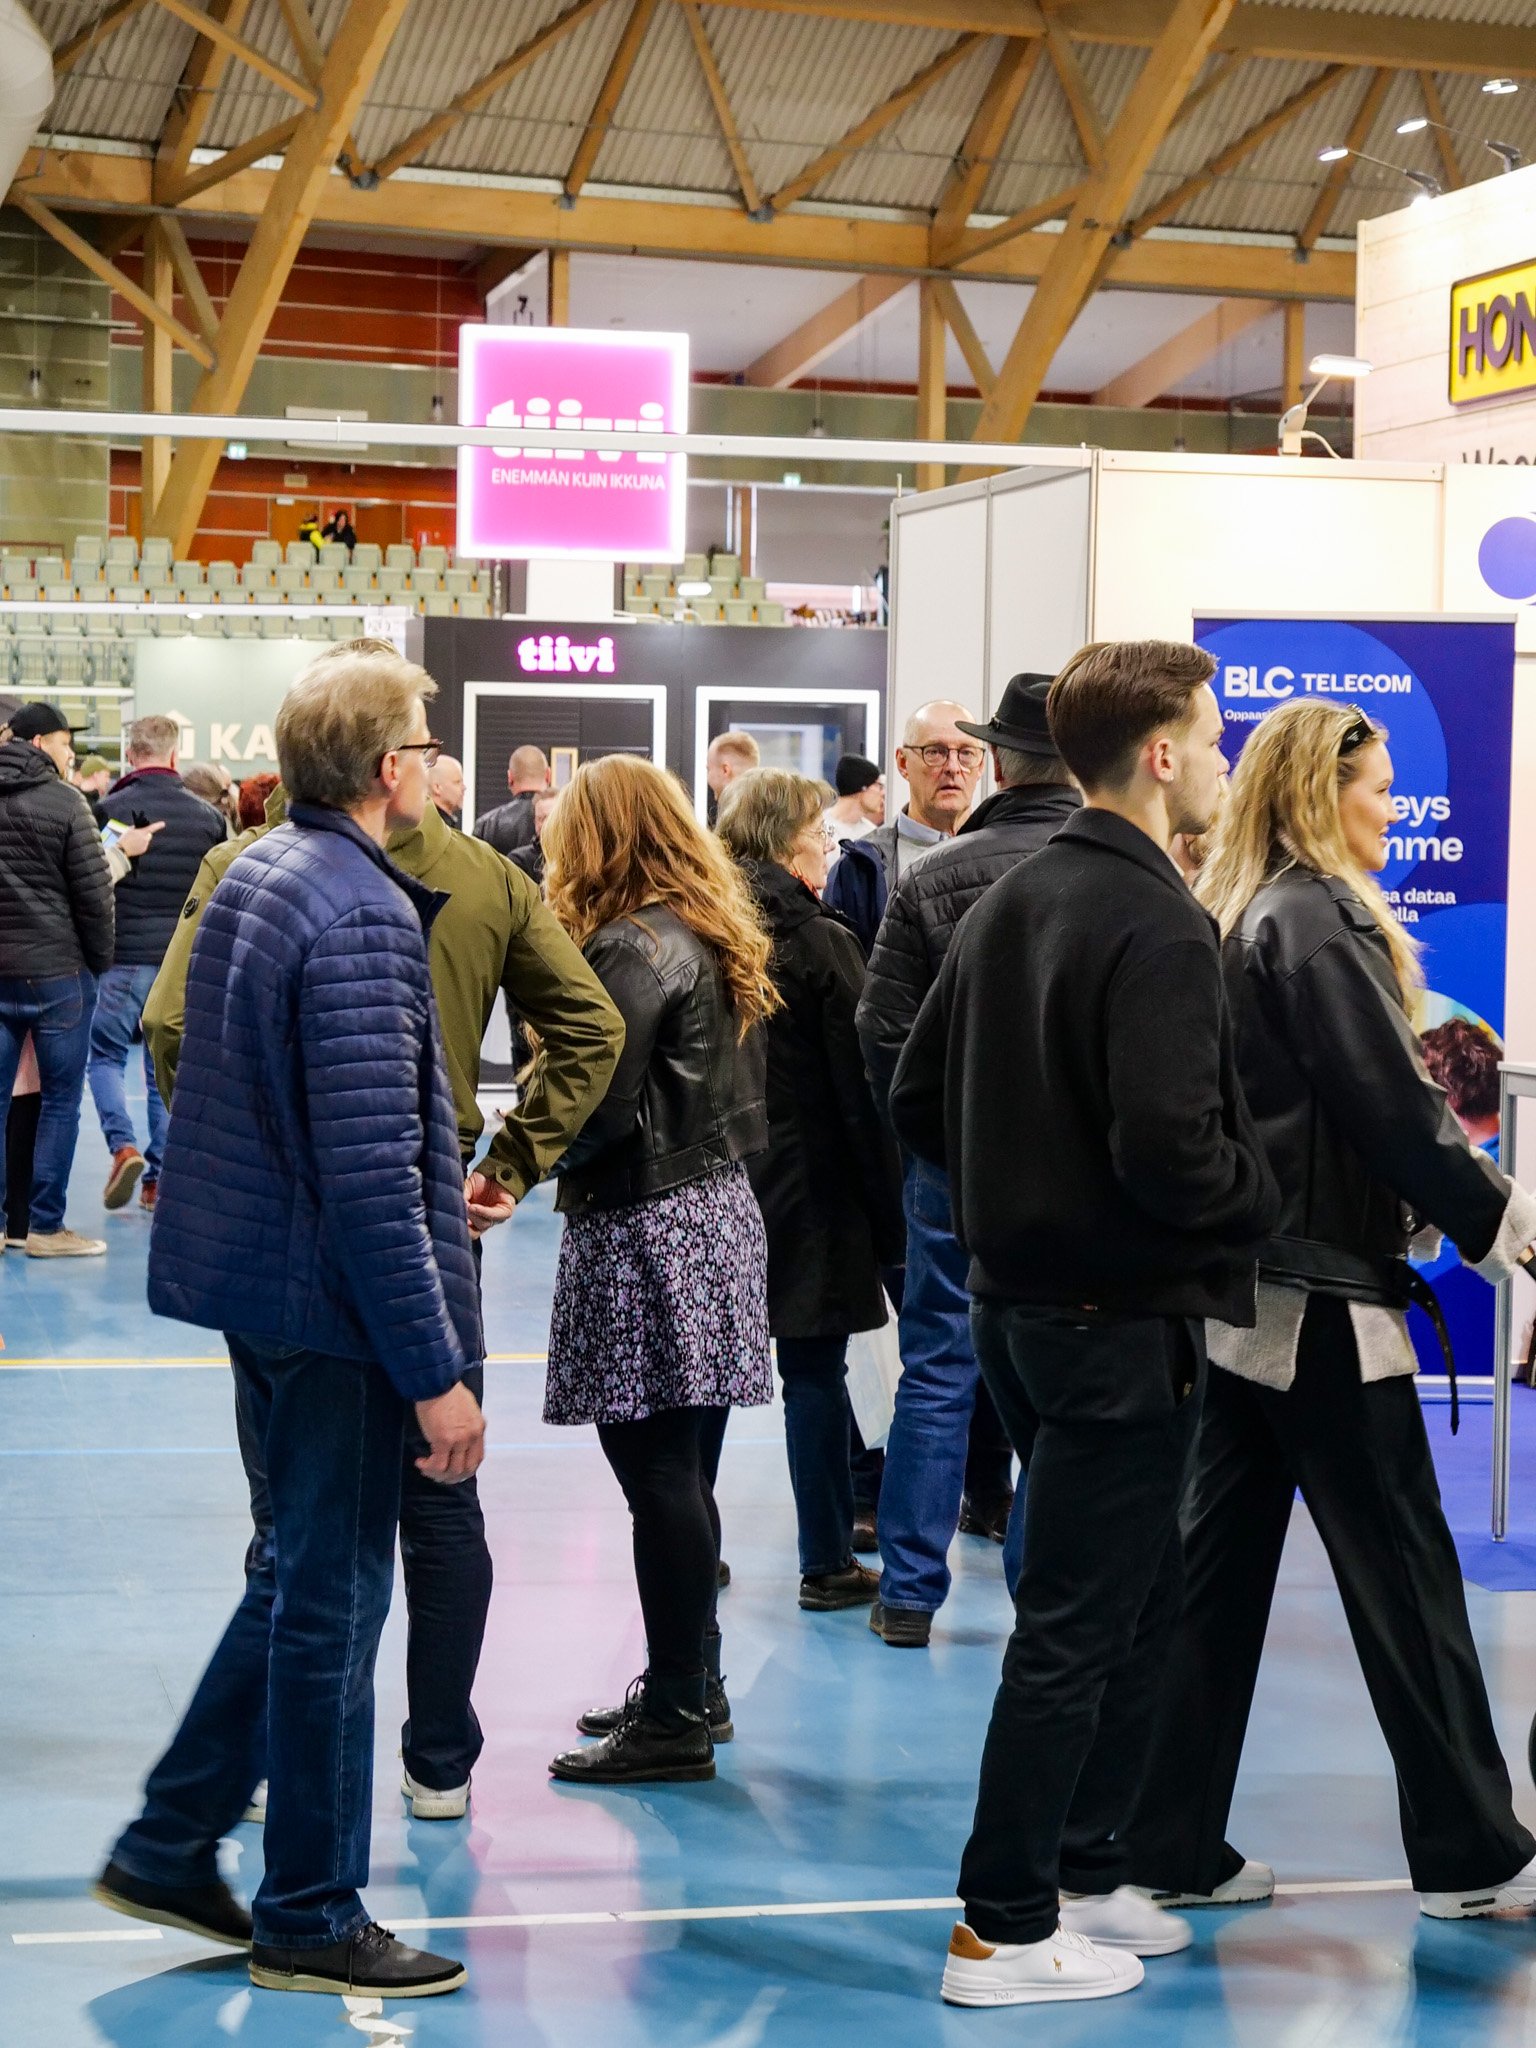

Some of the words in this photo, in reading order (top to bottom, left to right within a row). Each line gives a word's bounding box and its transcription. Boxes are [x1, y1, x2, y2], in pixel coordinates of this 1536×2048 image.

[491, 467, 569, 487] ENEMMÄN
[572, 471, 607, 488] KUIN
[610, 473, 666, 490] IKKUNA
[517, 635, 615, 673] tiivi
[1224, 666, 1295, 698] BLC
[1301, 673, 1412, 693] TELECOM
[210, 723, 279, 761] KA
[1403, 887, 1457, 905] dataa
